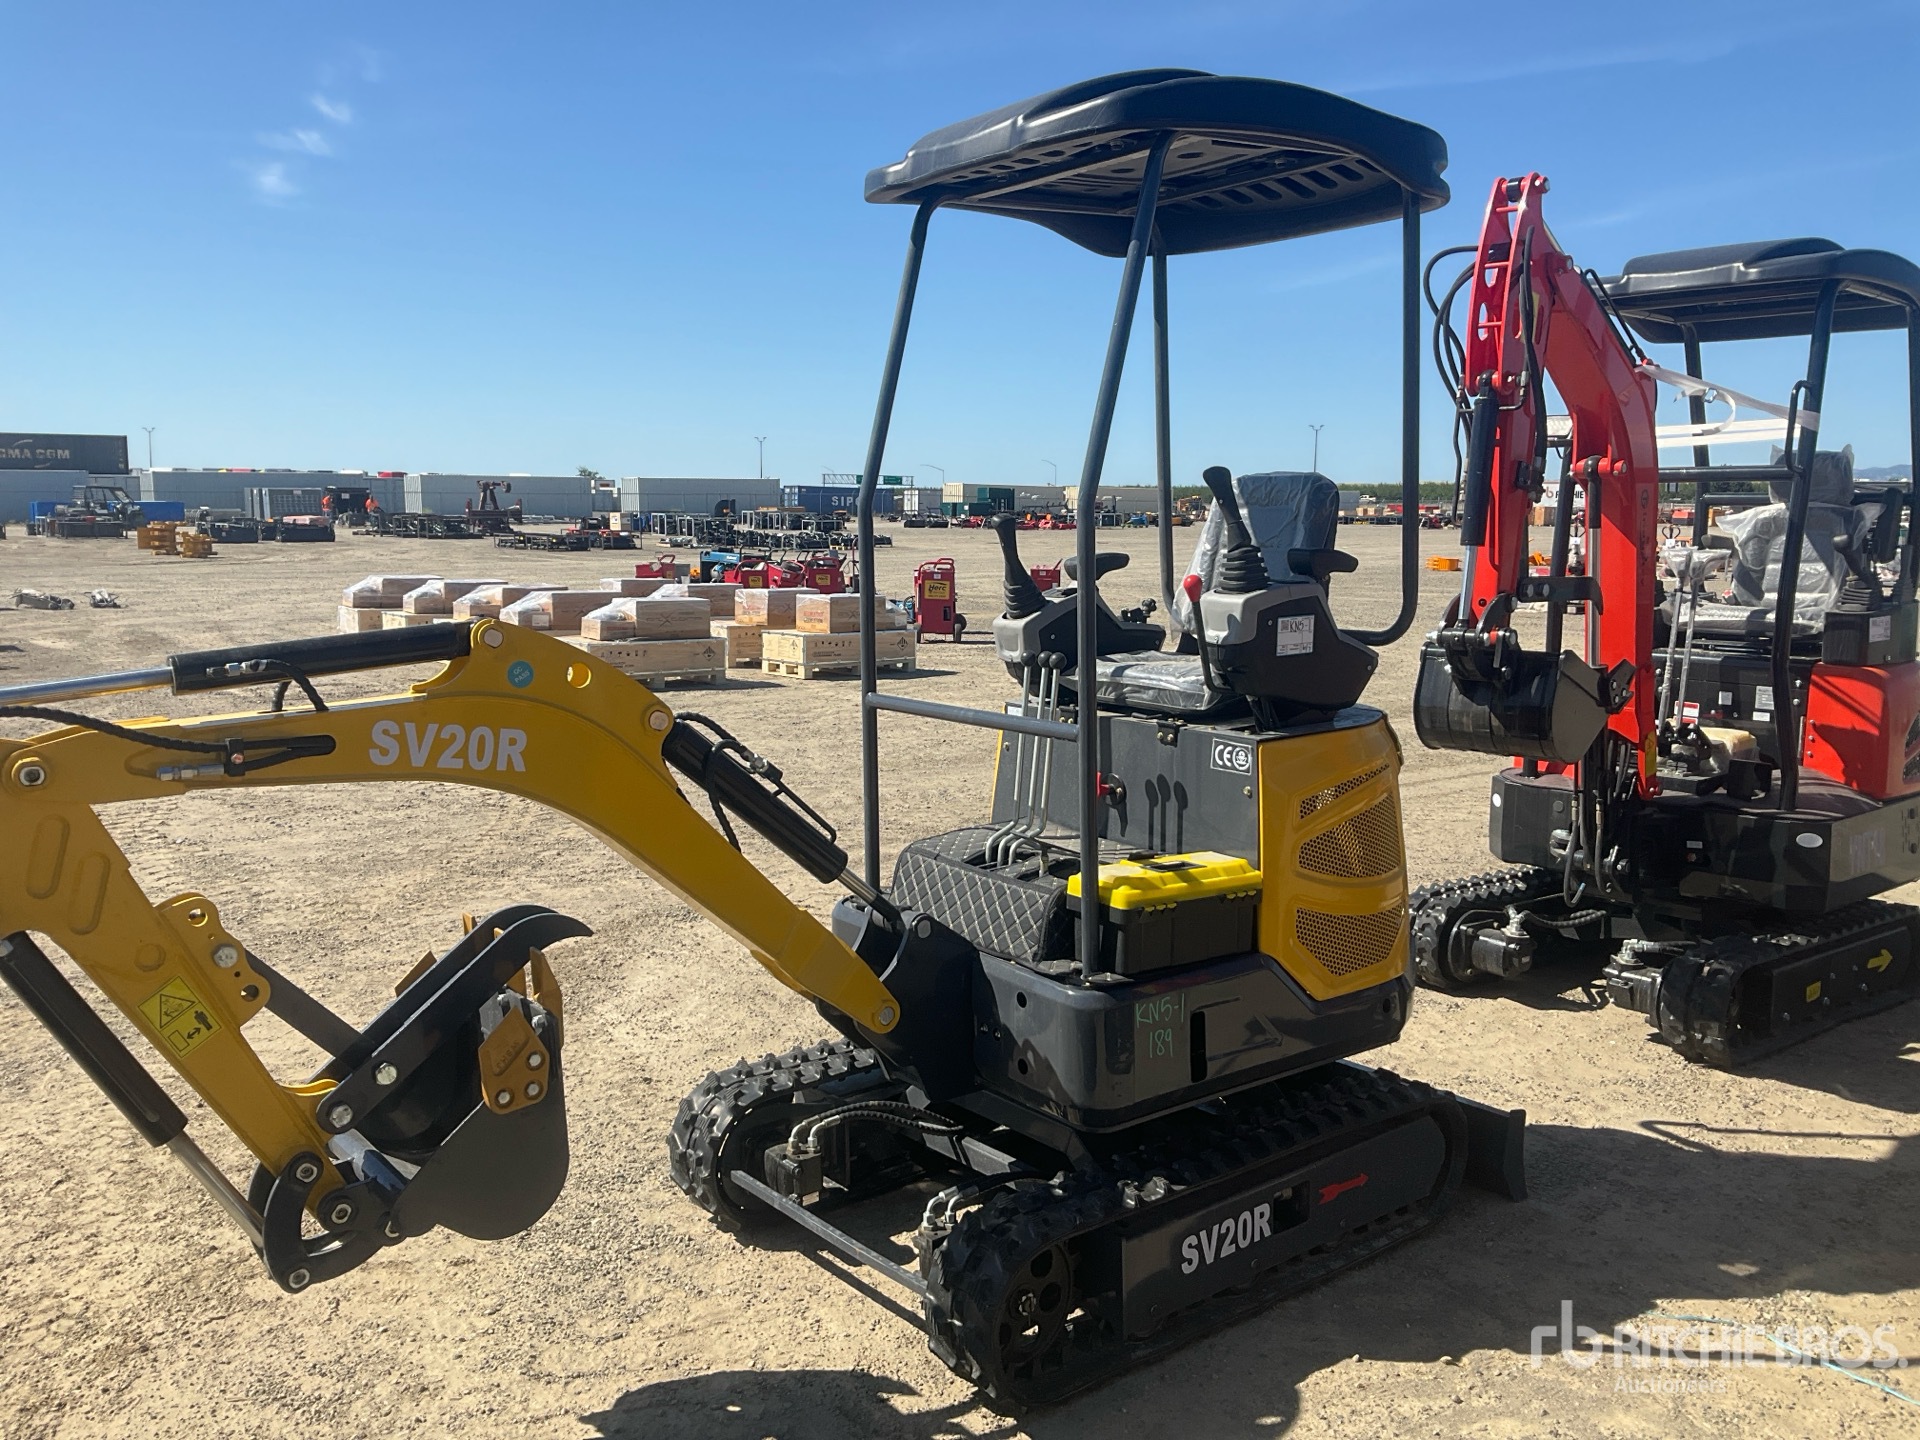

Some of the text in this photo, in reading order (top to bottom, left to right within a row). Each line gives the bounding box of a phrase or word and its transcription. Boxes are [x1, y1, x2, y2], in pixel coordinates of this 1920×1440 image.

[831, 496, 859, 507] SIP
[368, 720, 528, 772] SV20R
[1135, 992, 1185, 1029] KN5-1
[1149, 1028, 1174, 1058] 189
[1181, 1203, 1272, 1275] SV20R
